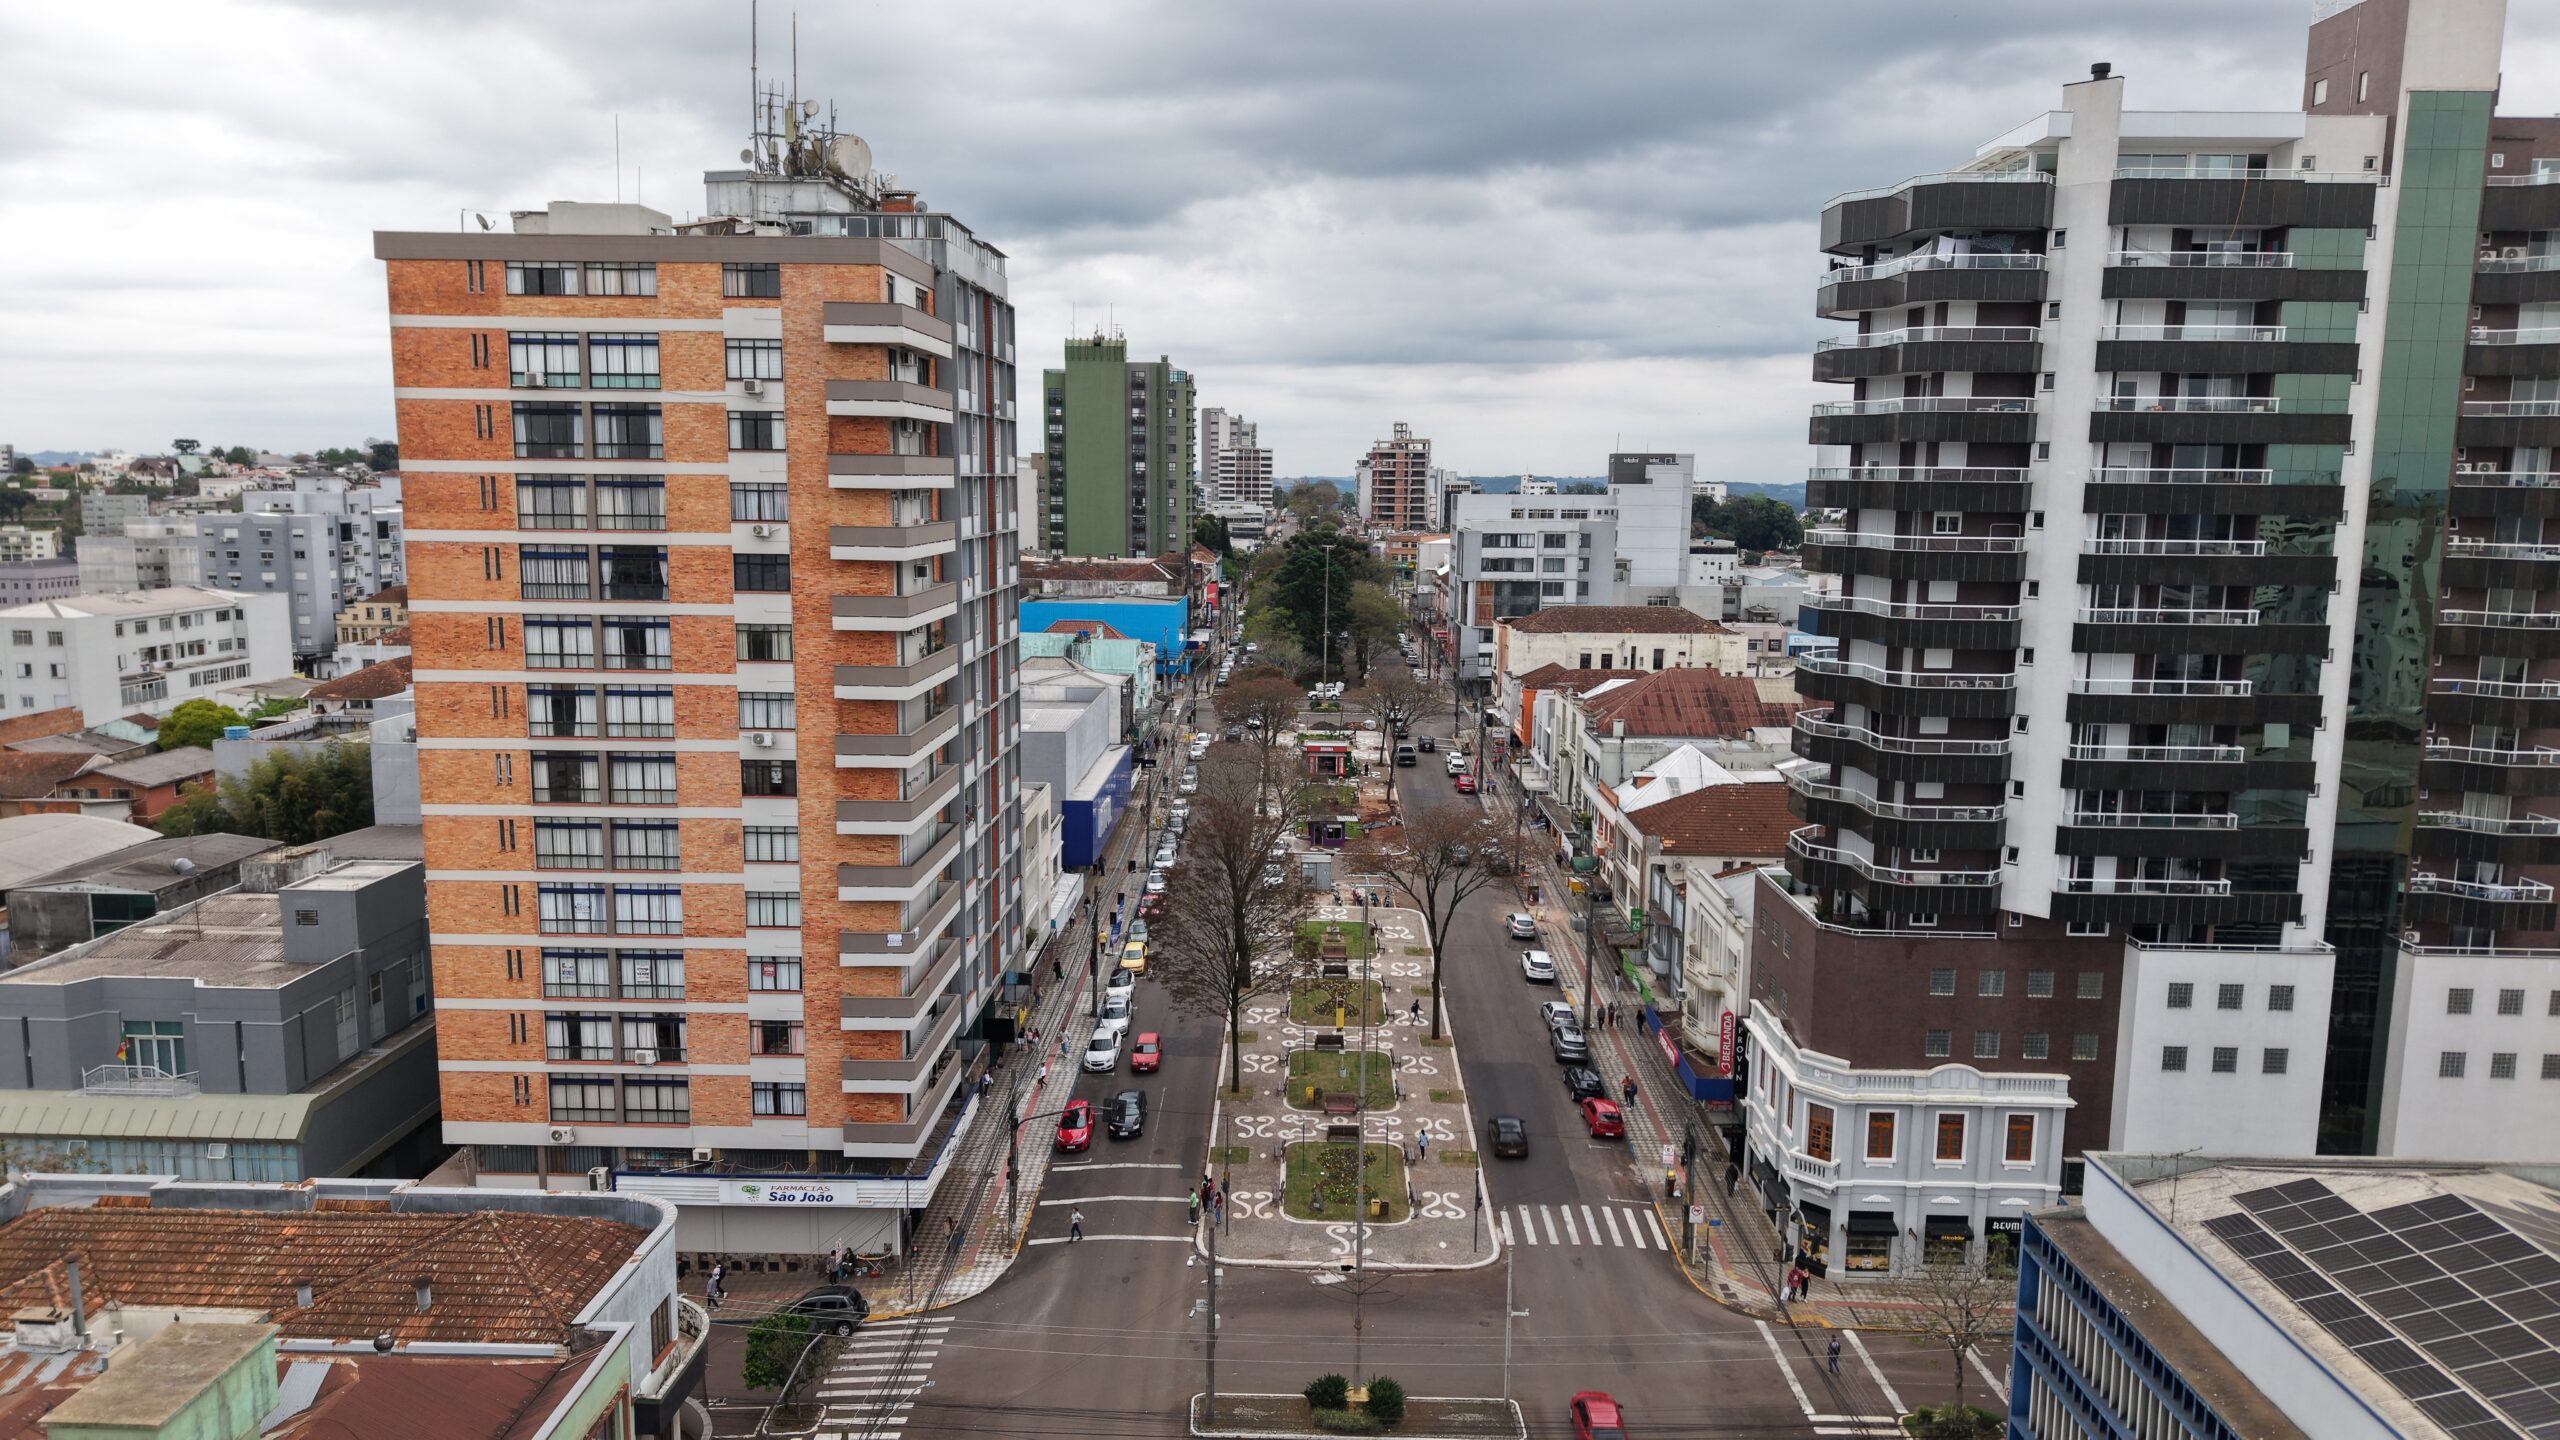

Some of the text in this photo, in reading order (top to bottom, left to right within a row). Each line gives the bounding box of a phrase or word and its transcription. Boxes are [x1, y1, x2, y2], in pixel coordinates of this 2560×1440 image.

[1722, 1014, 1732, 1061] BERLANDA
[1736, 1026, 1744, 1081] PROVIN
[768, 1191, 834, 1202] São João
